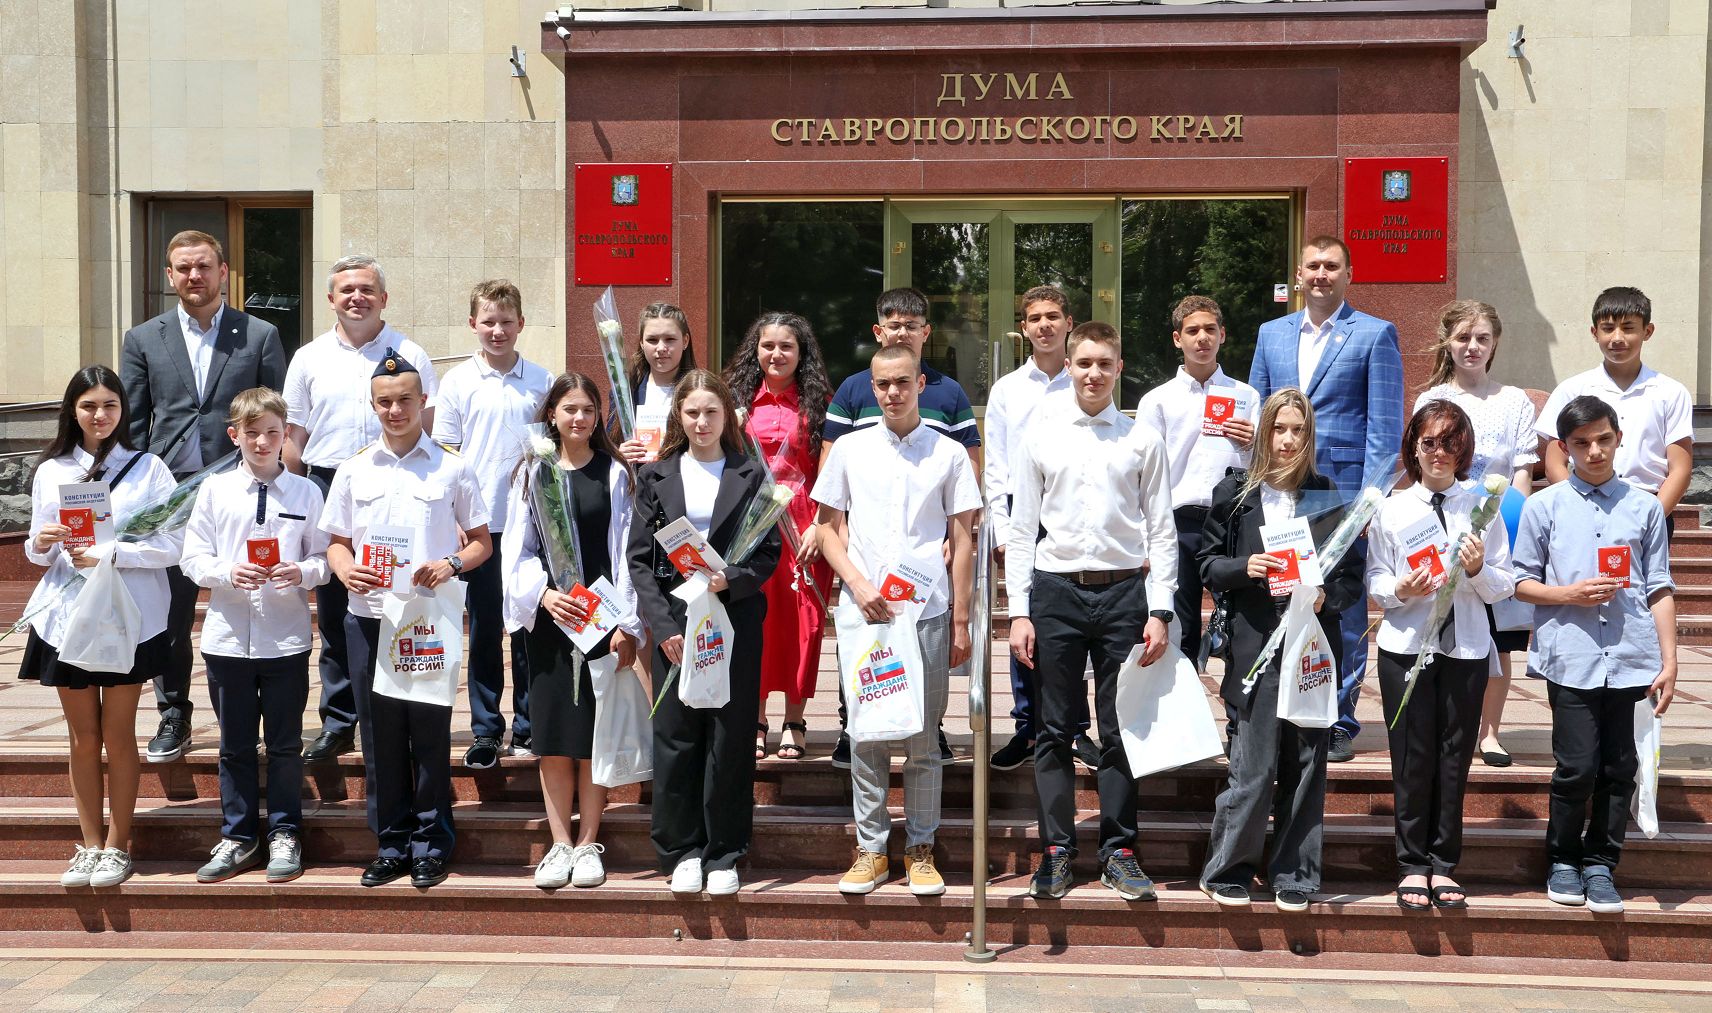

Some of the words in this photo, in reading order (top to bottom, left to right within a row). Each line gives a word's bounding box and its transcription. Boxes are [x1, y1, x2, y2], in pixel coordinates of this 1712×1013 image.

[937, 72, 1074, 107] ДУМА
[770, 116, 1138, 143] СТАВРОПОЛЬСКОГО
[1150, 115, 1245, 140] КРАЯ
[611, 220, 639, 232] ДУМА
[1382, 215, 1409, 227] ДУМА
[578, 233, 669, 246] СТАВРОПОЛЬСКОГО
[1350, 229, 1443, 241] СТАВРОПОЛЬСКОГО
[611, 247, 635, 258] КРАЯ
[1383, 243, 1408, 255] КРАЯ
[413, 624, 435, 636] МЫ
[399, 654, 445, 664] ГРАЖДАНЕ
[869, 646, 893, 663] МЫ
[394, 661, 445, 673] РОССИИ!
[862, 674, 908, 694] ГРАЖДАНЕ
[858, 681, 909, 705] РОССИИ!
